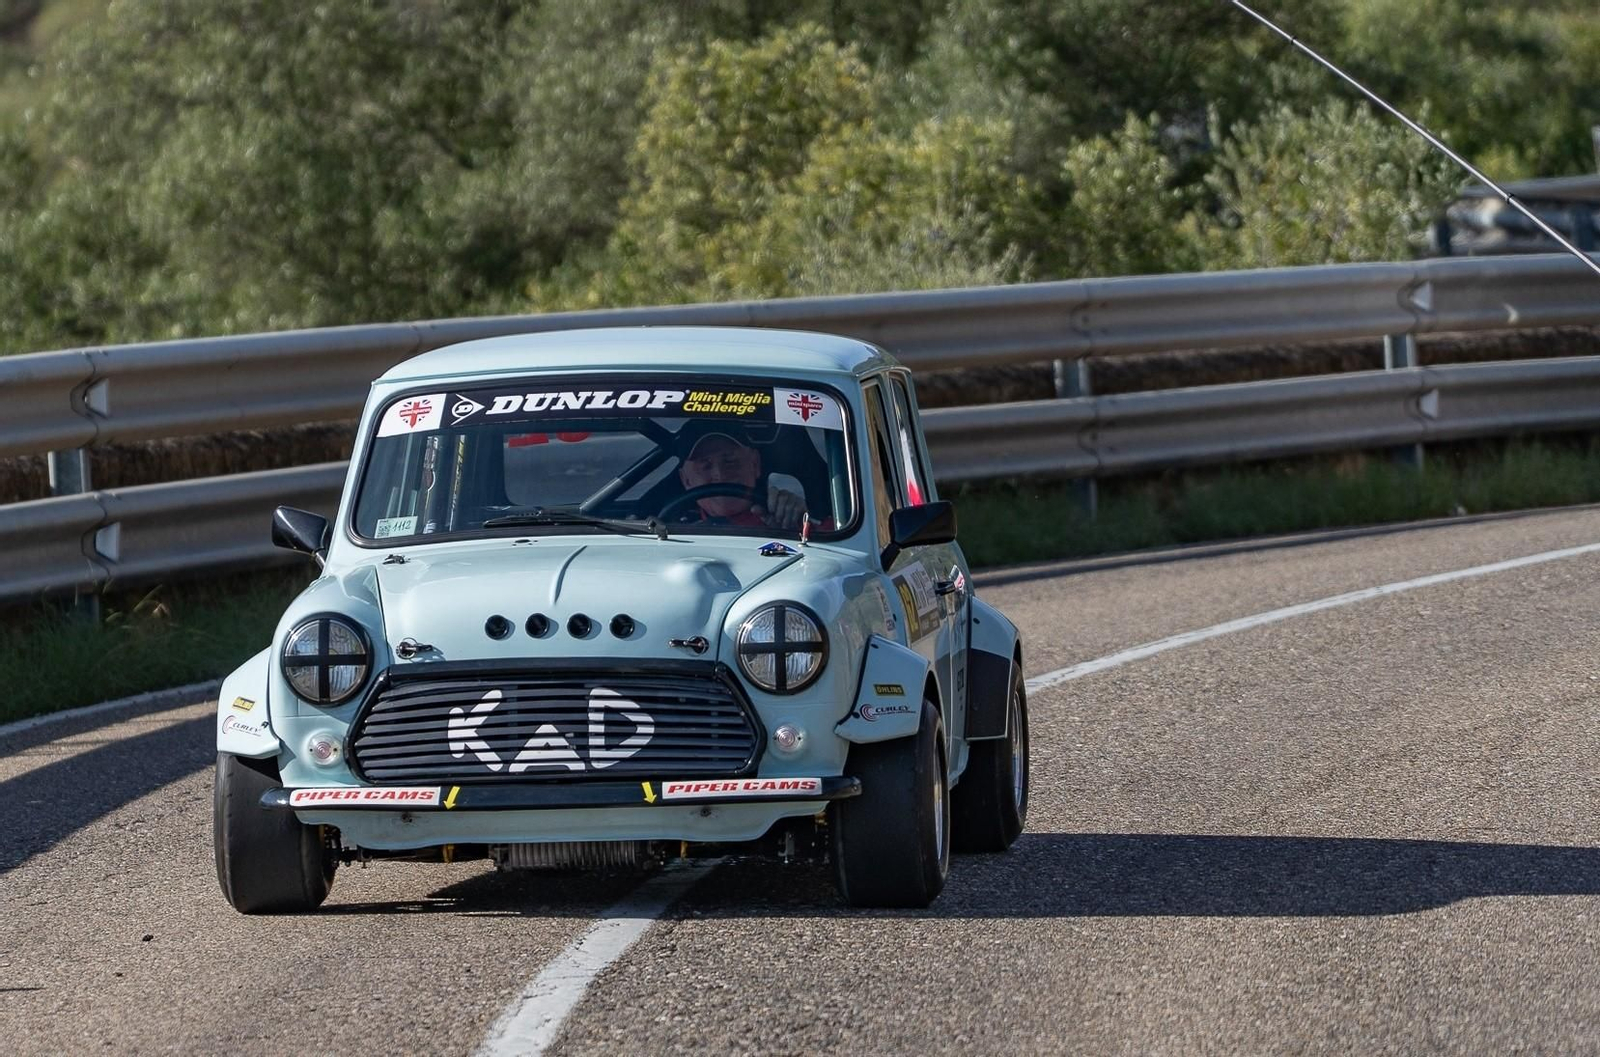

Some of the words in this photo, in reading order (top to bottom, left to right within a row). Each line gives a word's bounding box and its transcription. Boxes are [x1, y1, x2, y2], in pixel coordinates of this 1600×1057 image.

[485, 390, 685, 415] DUNLOP
[688, 391, 724, 402] Mini
[725, 393, 771, 405] Miglia
[683, 401, 756, 415] Challenge
[447, 687, 655, 772] KAD
[668, 782, 739, 794] PIPER
[742, 780, 817, 791] CAMS
[294, 791, 361, 802] PIPER
[364, 790, 436, 801] CAMS
